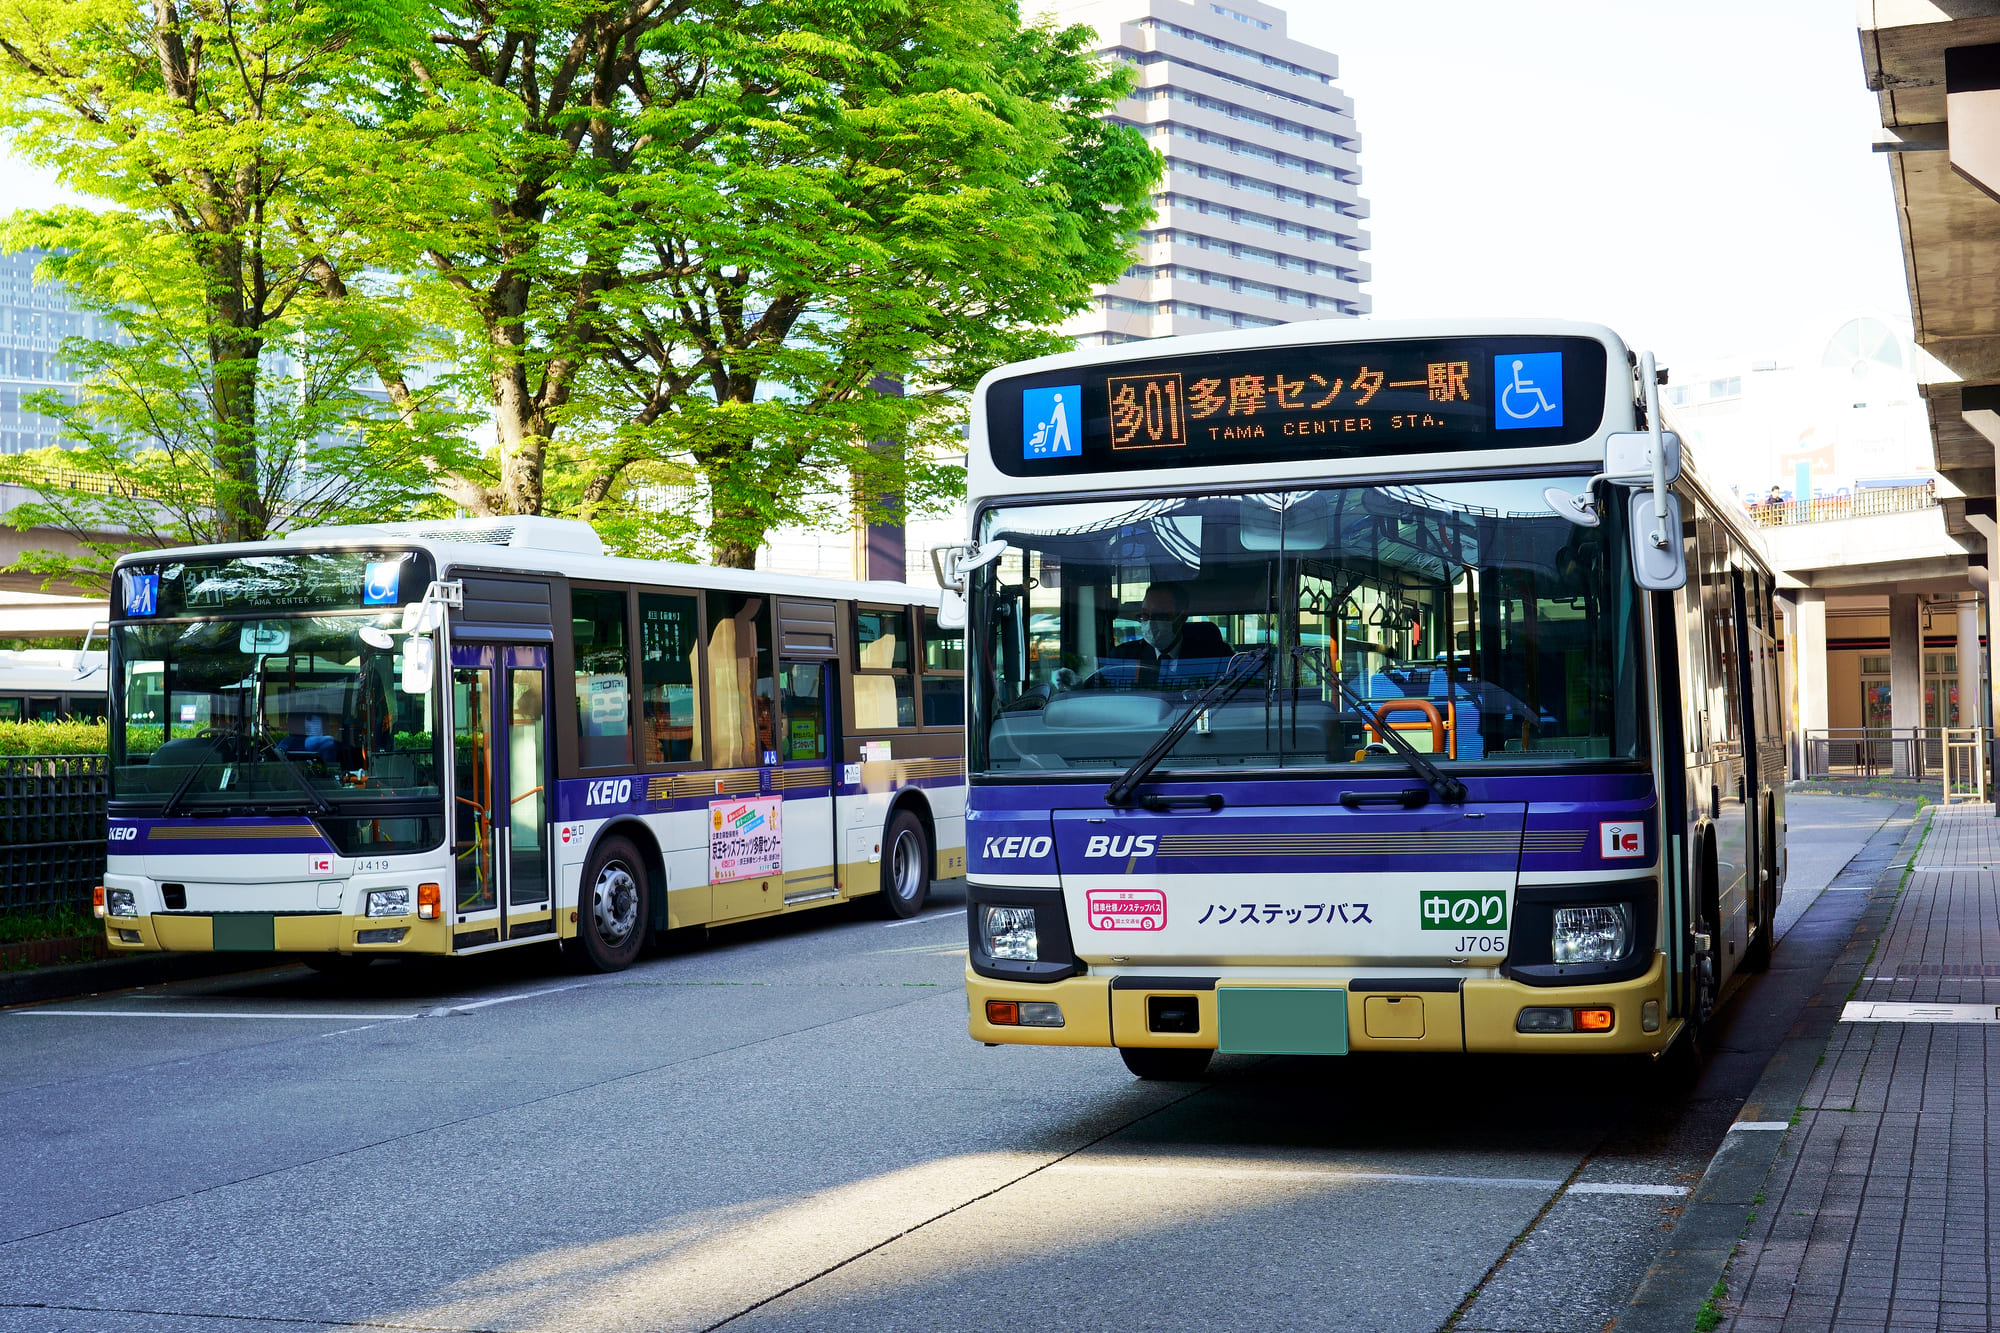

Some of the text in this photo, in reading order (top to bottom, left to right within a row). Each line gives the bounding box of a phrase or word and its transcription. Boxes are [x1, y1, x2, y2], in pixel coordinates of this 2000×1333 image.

[1188, 361, 1470, 419] 多摩センター駅
[1208, 412, 1445, 441] TAMA CENTER STA.
[248, 595, 337, 607] TAMA CENTER STA.
[586, 779, 631, 806] KEIO
[109, 827, 137, 841] KEIO
[982, 835, 1158, 858] KEIO BUS
[358, 860, 389, 871] J419
[1198, 902, 1373, 925] ノンステップバス
[1423, 895, 1503, 925] 中のり
[1455, 936, 1505, 953] J705
